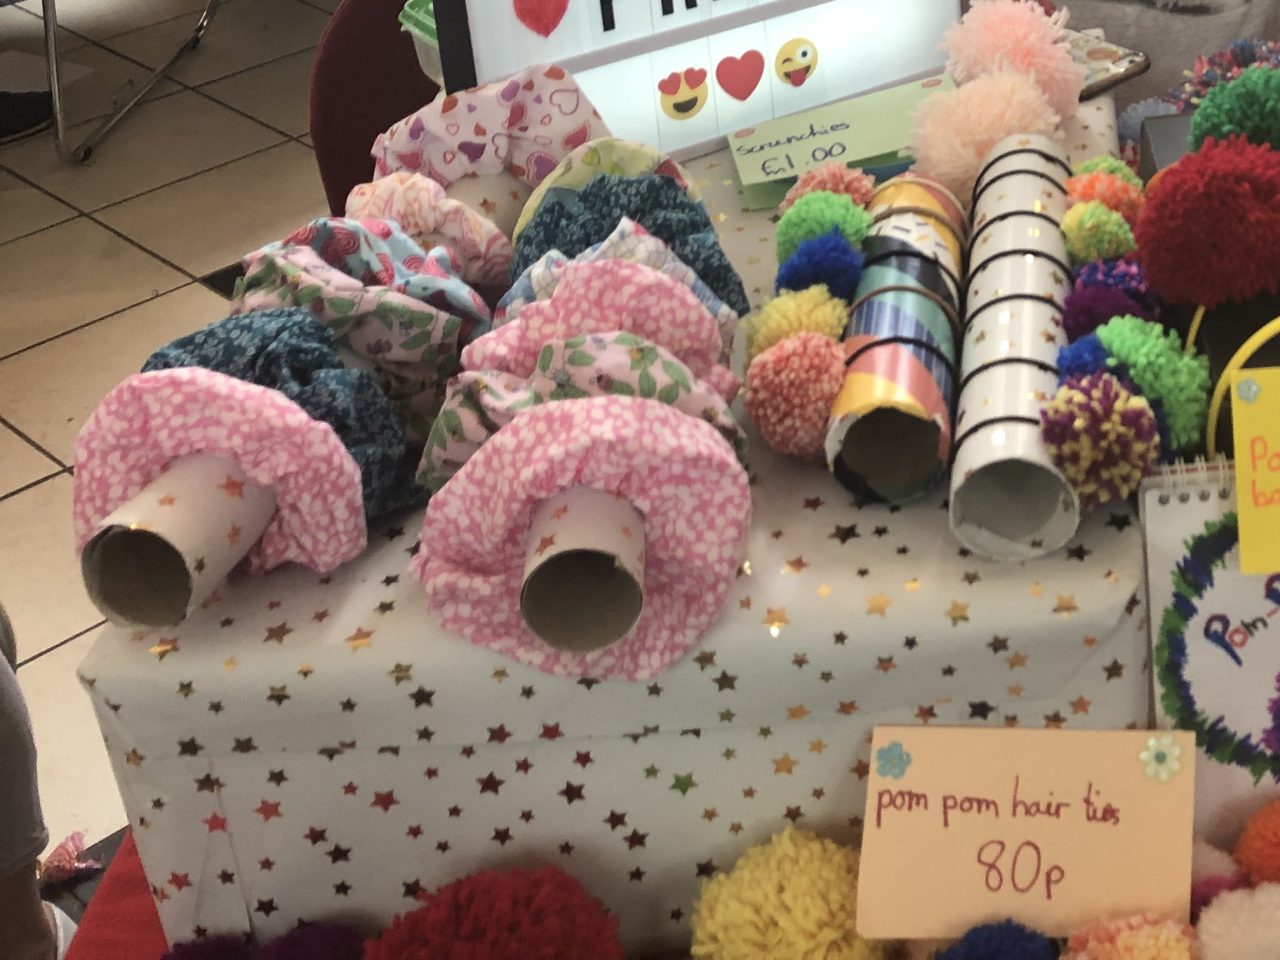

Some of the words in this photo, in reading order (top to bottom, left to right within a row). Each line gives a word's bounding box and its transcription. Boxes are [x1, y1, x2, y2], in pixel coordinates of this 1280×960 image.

[761, 142, 847, 176] £1.00
[876, 789, 929, 828] pom
[942, 794, 999, 828] pom
[1012, 775, 1070, 818] hair
[1083, 781, 1120, 826] ties
[977, 839, 1065, 900] 80p
